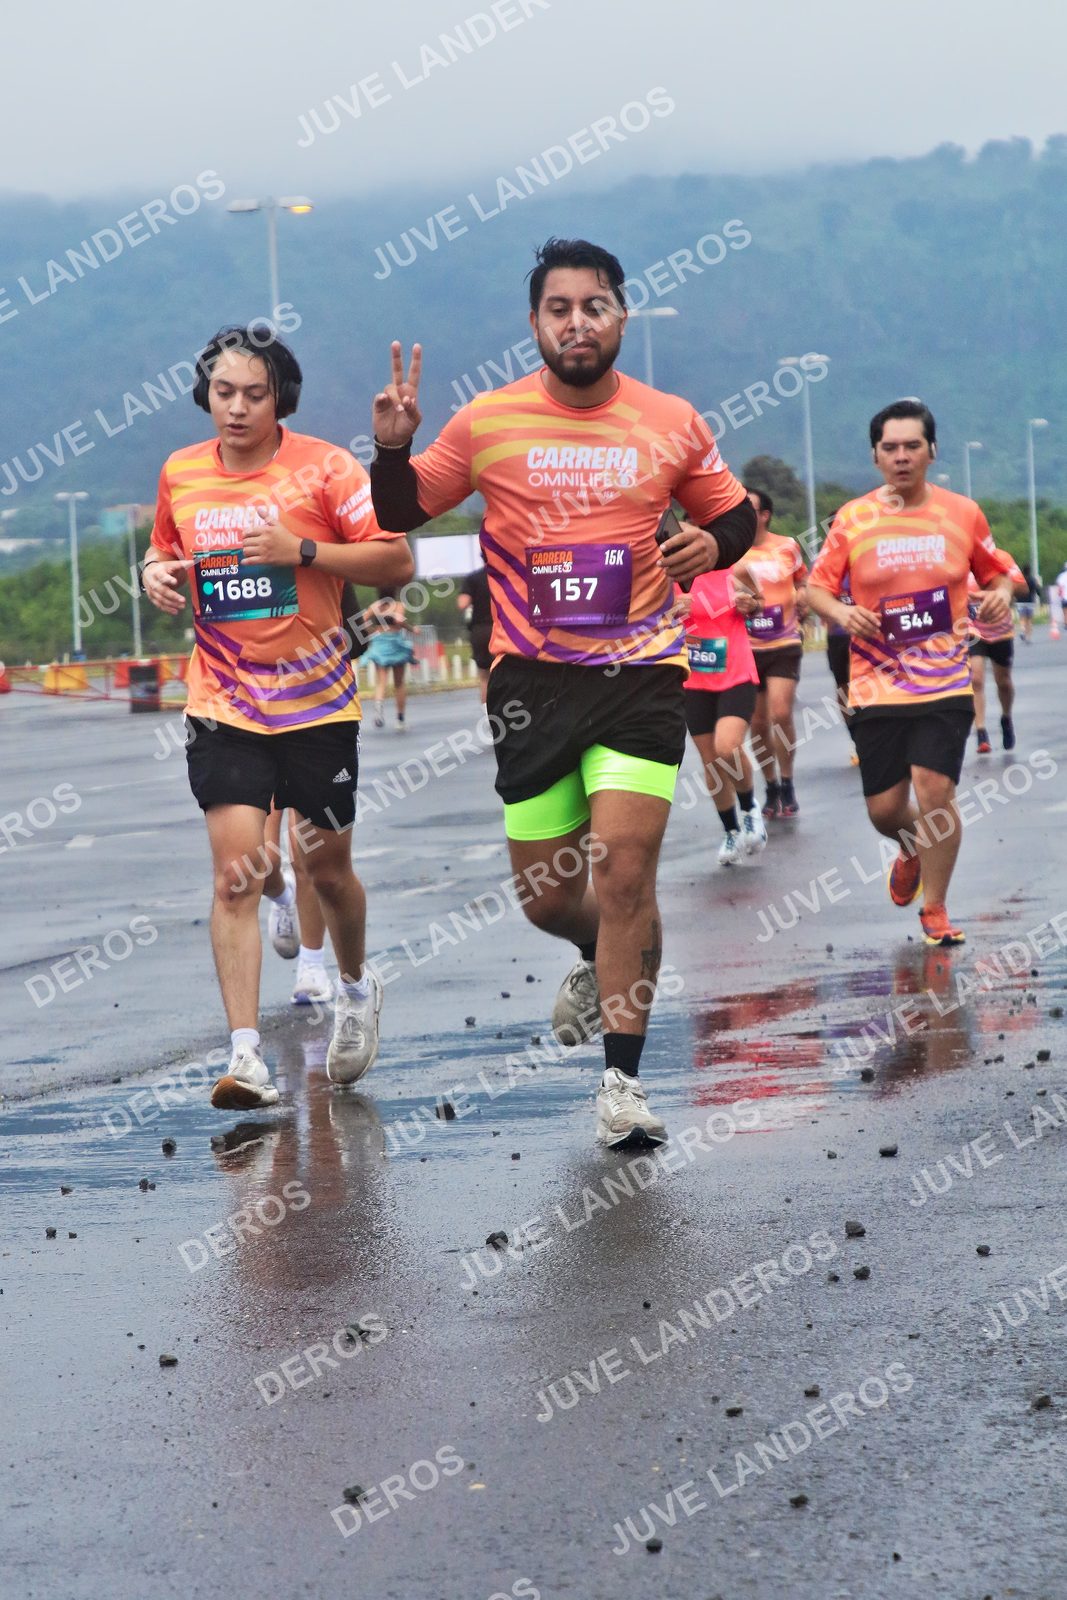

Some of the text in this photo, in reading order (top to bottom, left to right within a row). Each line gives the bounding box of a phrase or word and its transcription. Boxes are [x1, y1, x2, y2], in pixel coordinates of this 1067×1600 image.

[527, 446, 638, 469] CARRERA
[877, 534, 945, 558] CARRERA
[200, 554, 238, 570] CARRERA
[532, 550, 573, 567] CARRERA
[213, 576, 273, 602] 1688
[550, 577, 598, 602] 157
[753, 617, 774, 629] 686
[900, 612, 933, 631] 544
